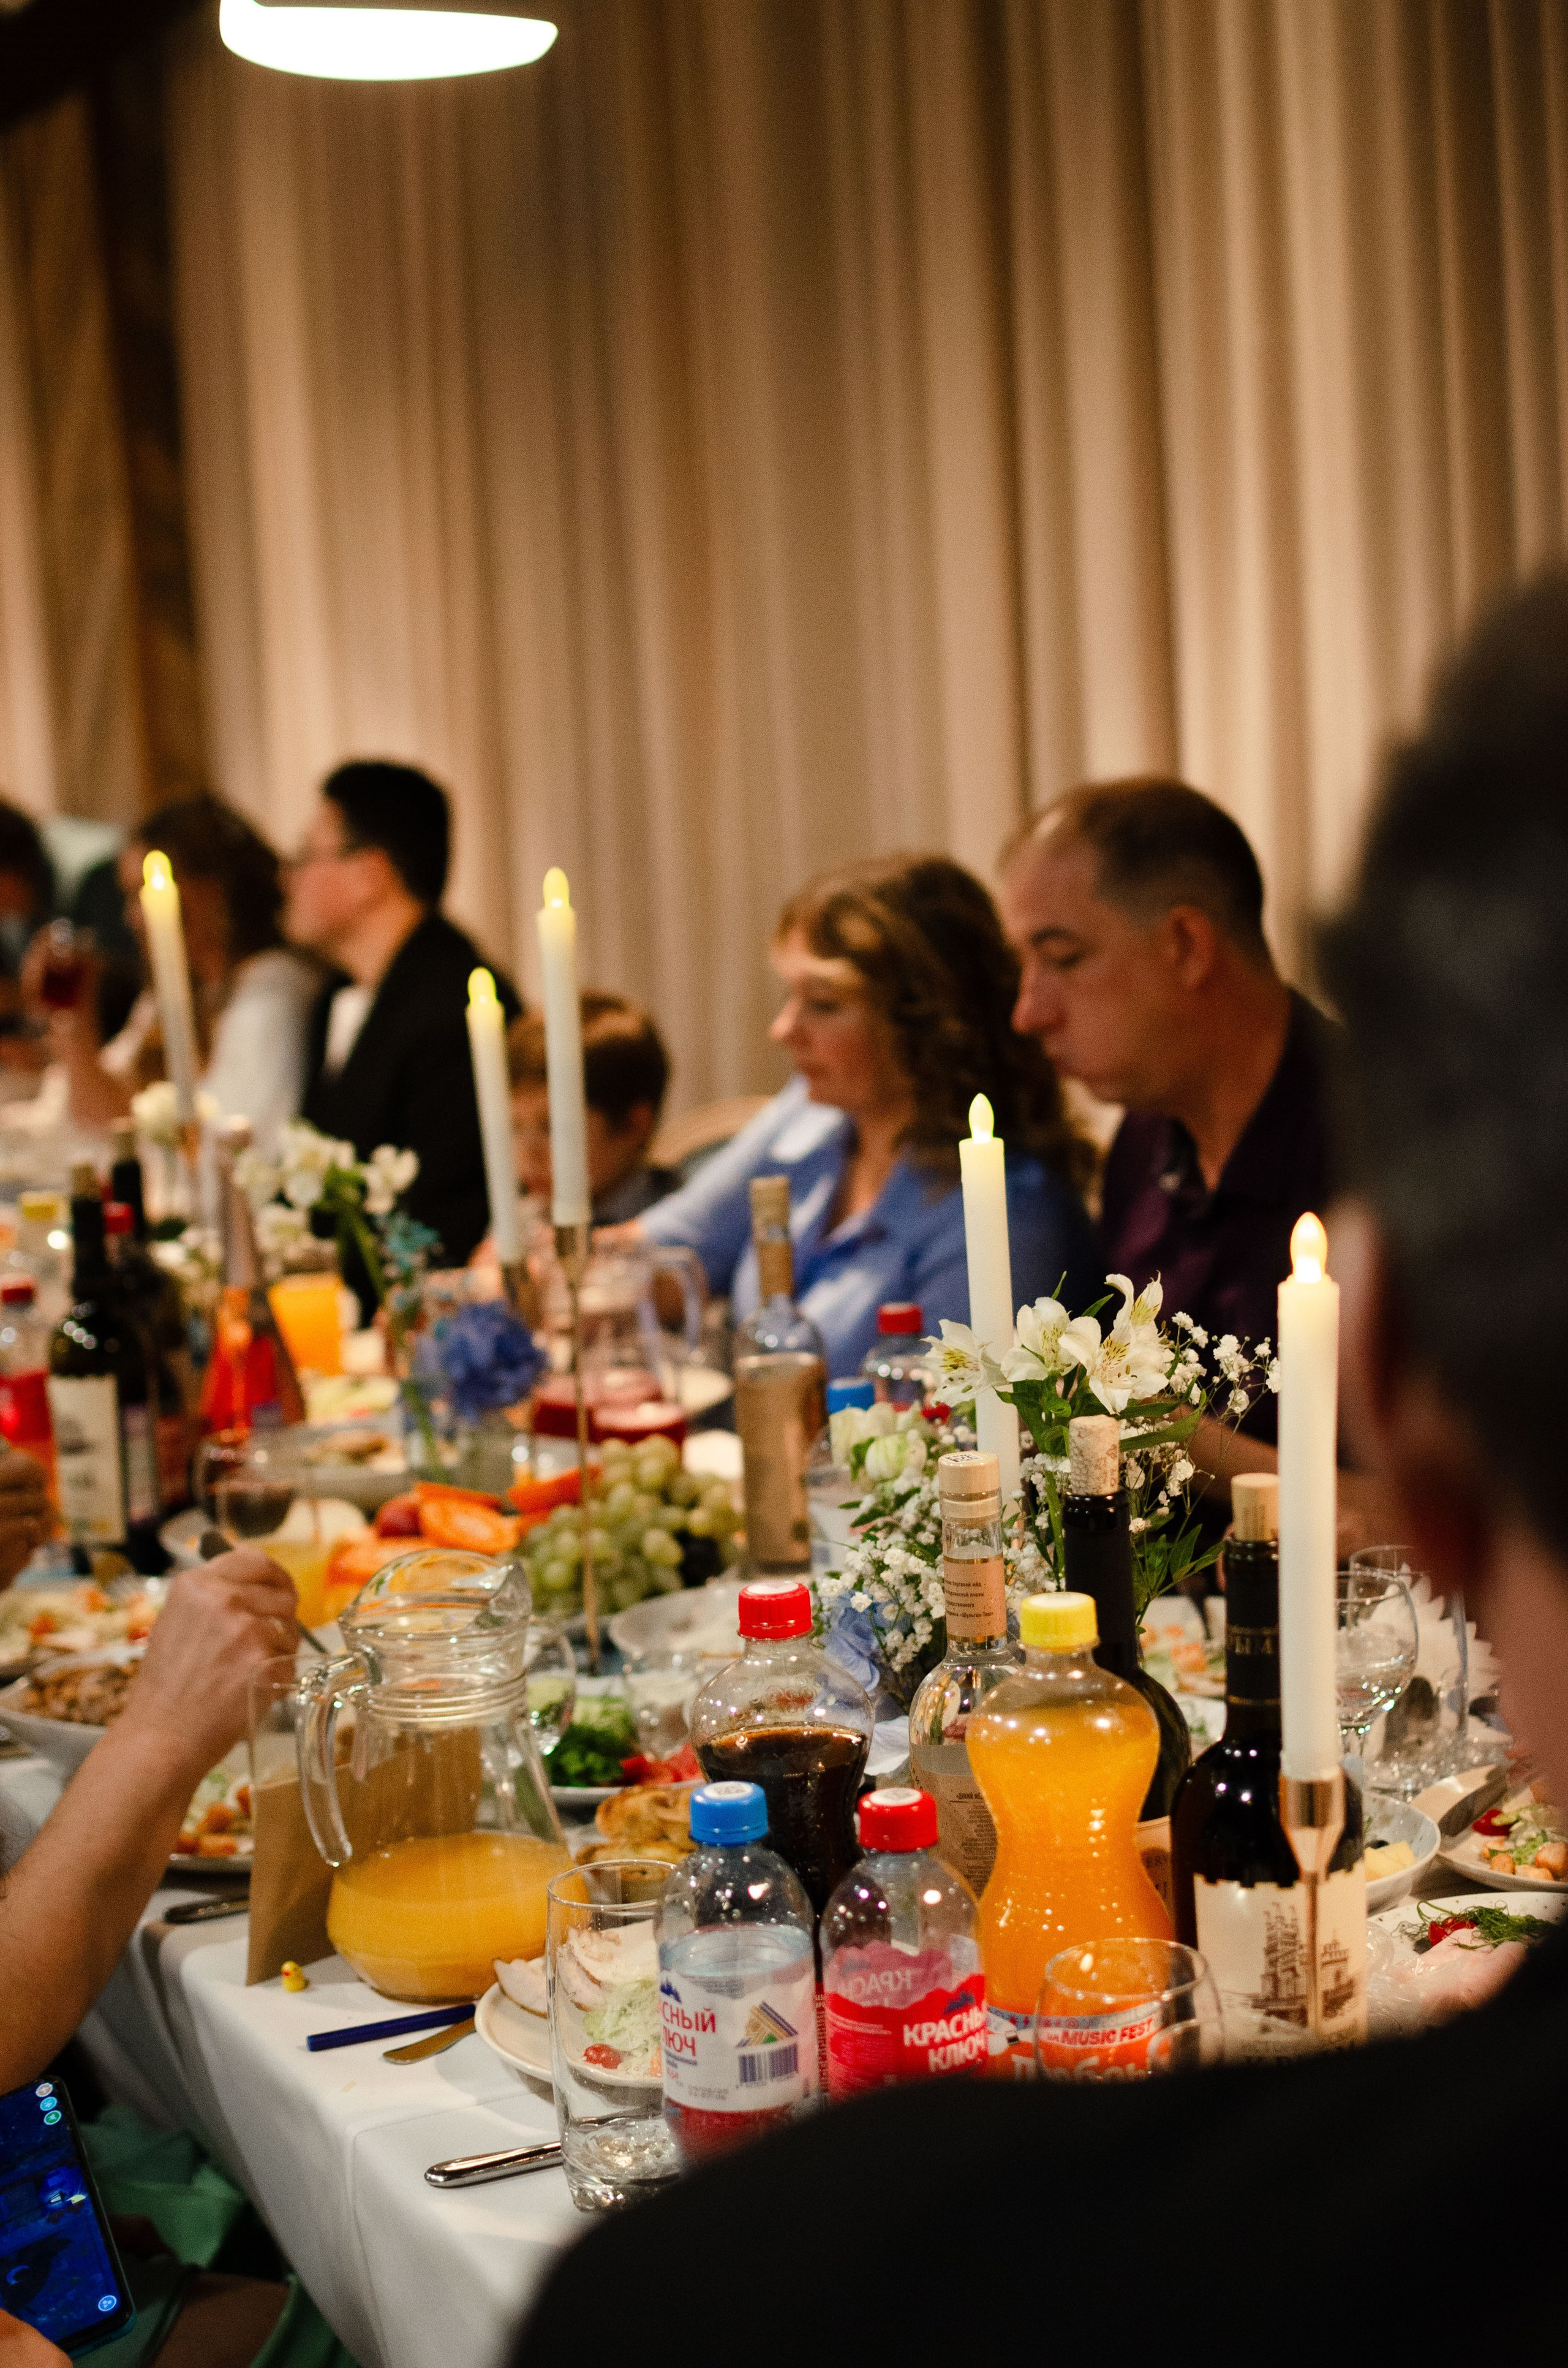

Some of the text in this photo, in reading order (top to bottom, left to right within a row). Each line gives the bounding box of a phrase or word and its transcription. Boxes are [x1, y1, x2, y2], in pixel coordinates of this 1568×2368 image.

[662, 2001, 716, 2033] СНЫЙ
[1061, 2029, 1117, 2045] MUSIC
[1119, 2017, 1153, 2042] FEST
